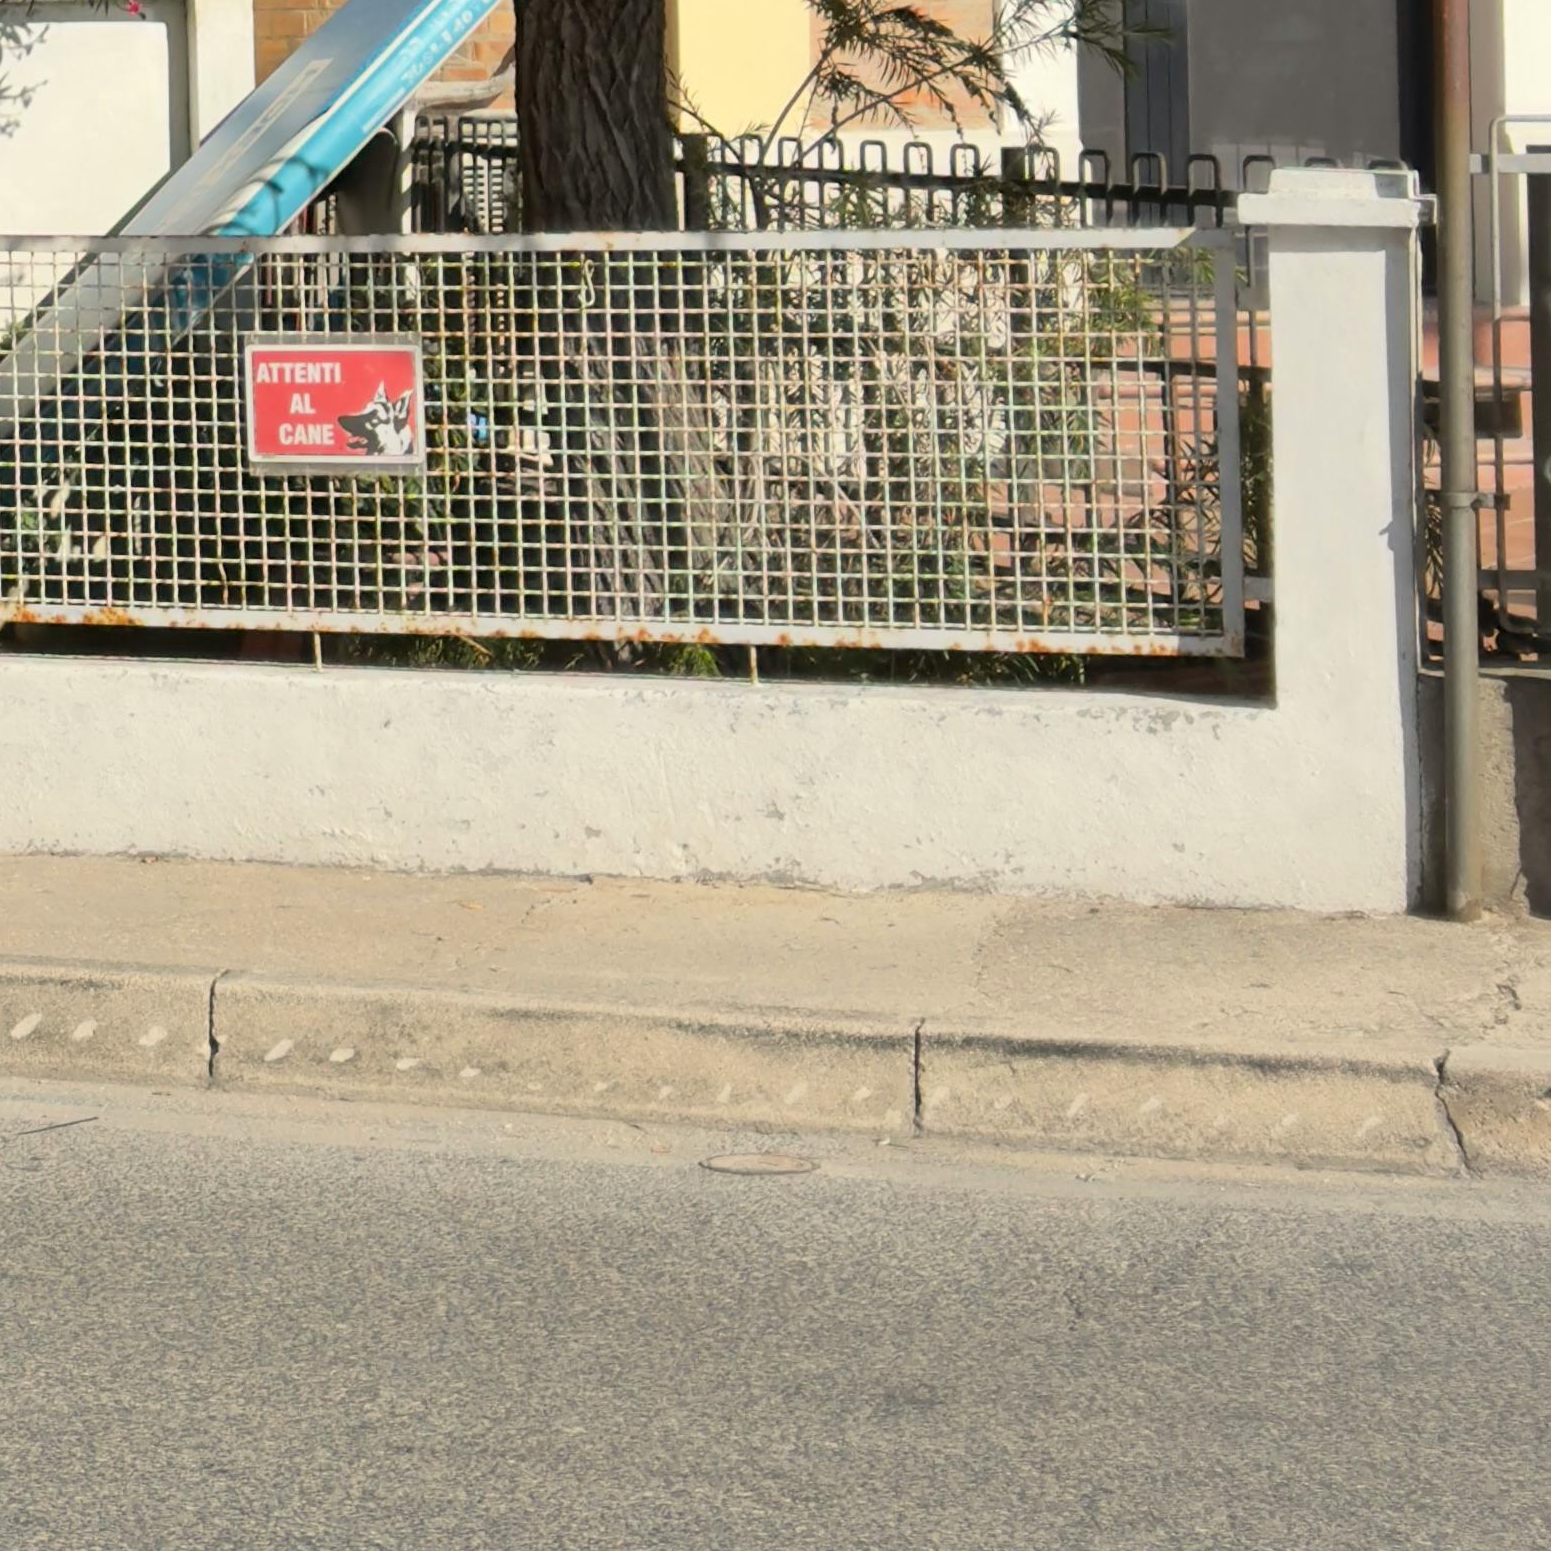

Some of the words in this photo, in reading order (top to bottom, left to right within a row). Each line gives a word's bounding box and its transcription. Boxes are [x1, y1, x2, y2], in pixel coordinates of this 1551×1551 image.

[256, 362, 342, 384] ATTENTI
[290, 393, 316, 414] AL
[278, 423, 335, 445] CANE
